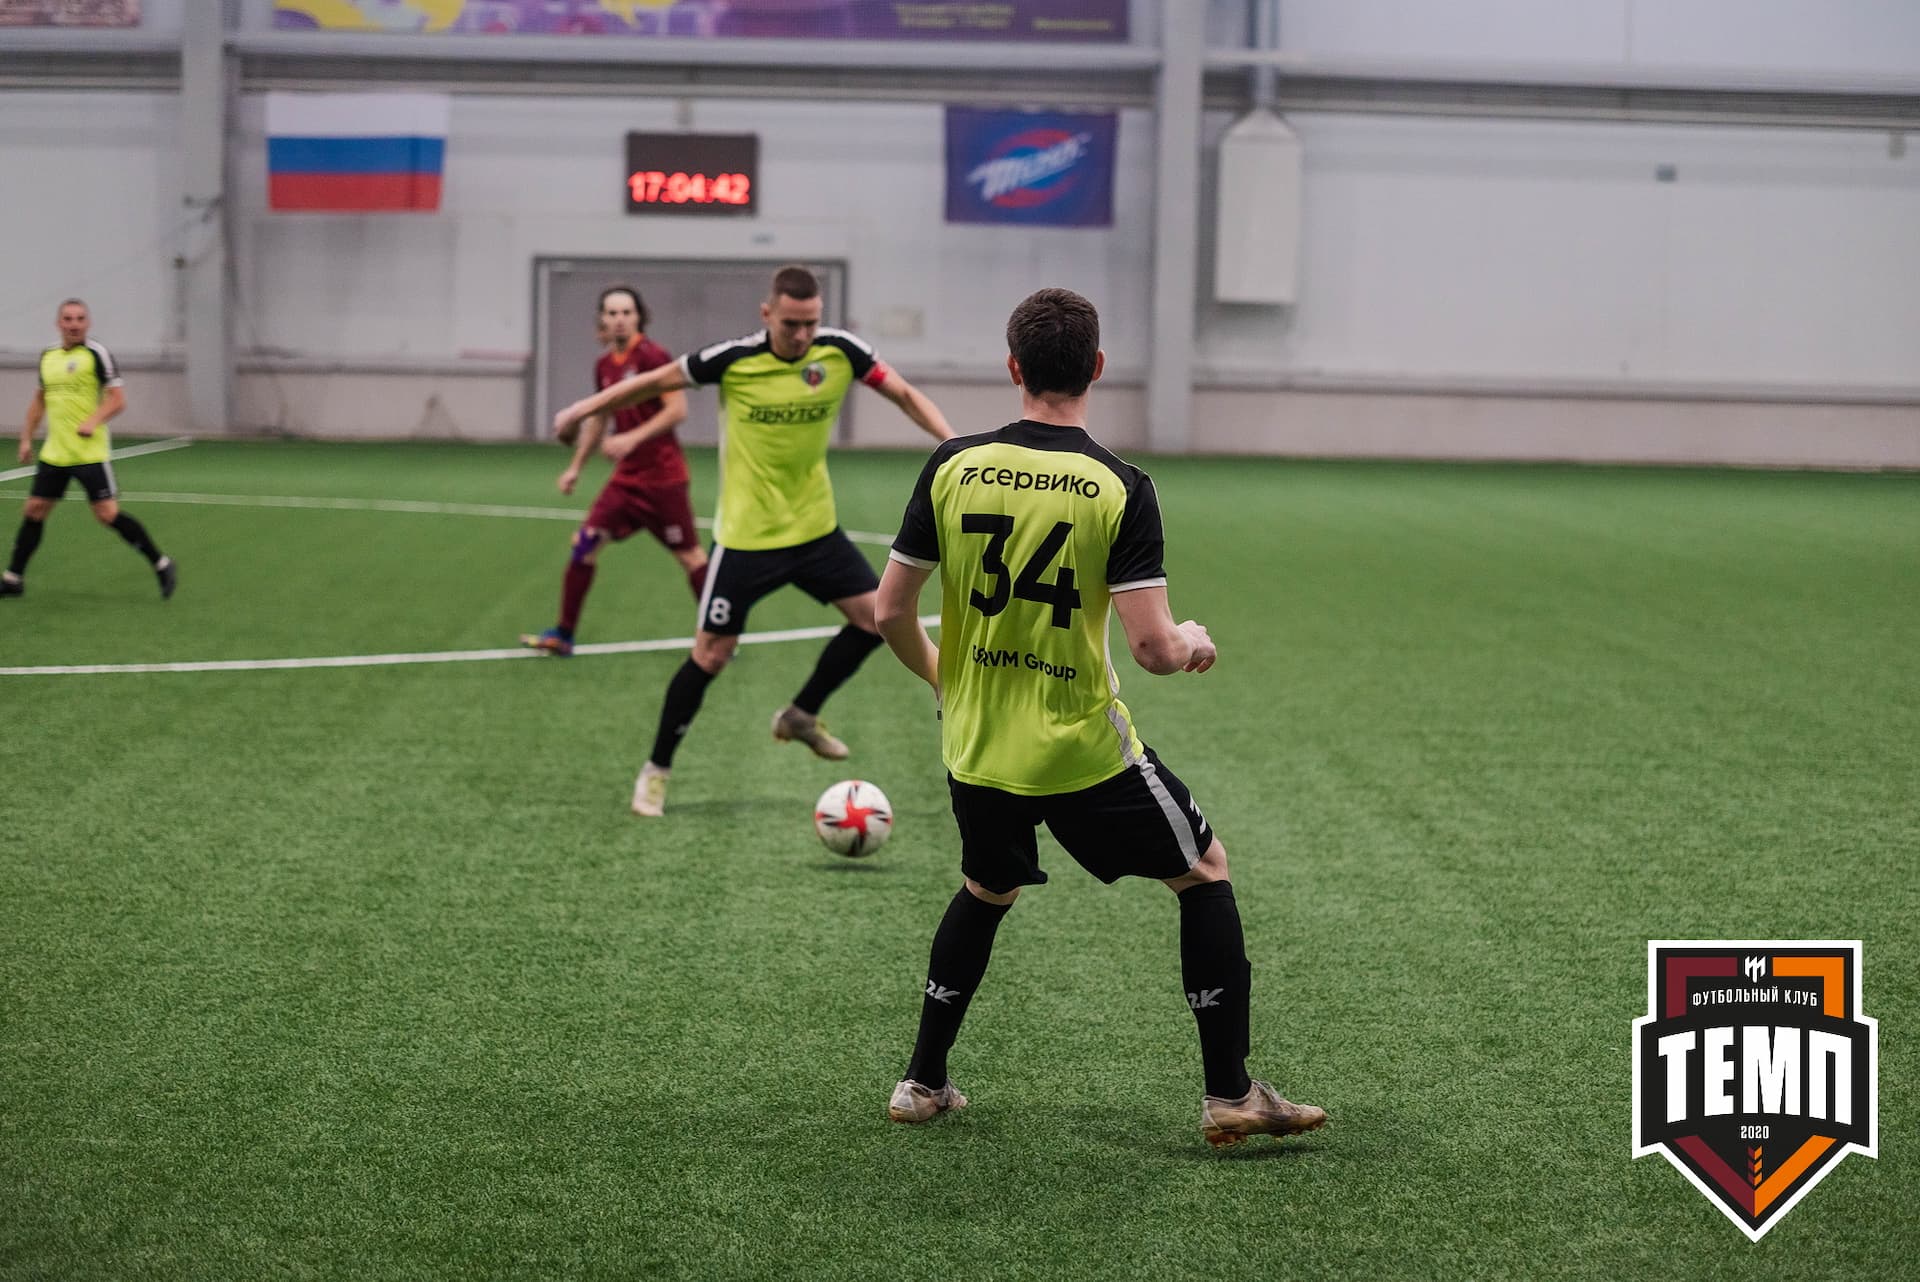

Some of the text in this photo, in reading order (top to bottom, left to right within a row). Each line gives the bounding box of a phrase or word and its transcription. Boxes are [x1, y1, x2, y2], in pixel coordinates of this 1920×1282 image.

[627, 170, 750, 205] 17:04:42
[981, 467, 1100, 499] сервико
[961, 513, 1081, 630] 34
[709, 597, 731, 625] 8
[1024, 653, 1077, 681] Group
